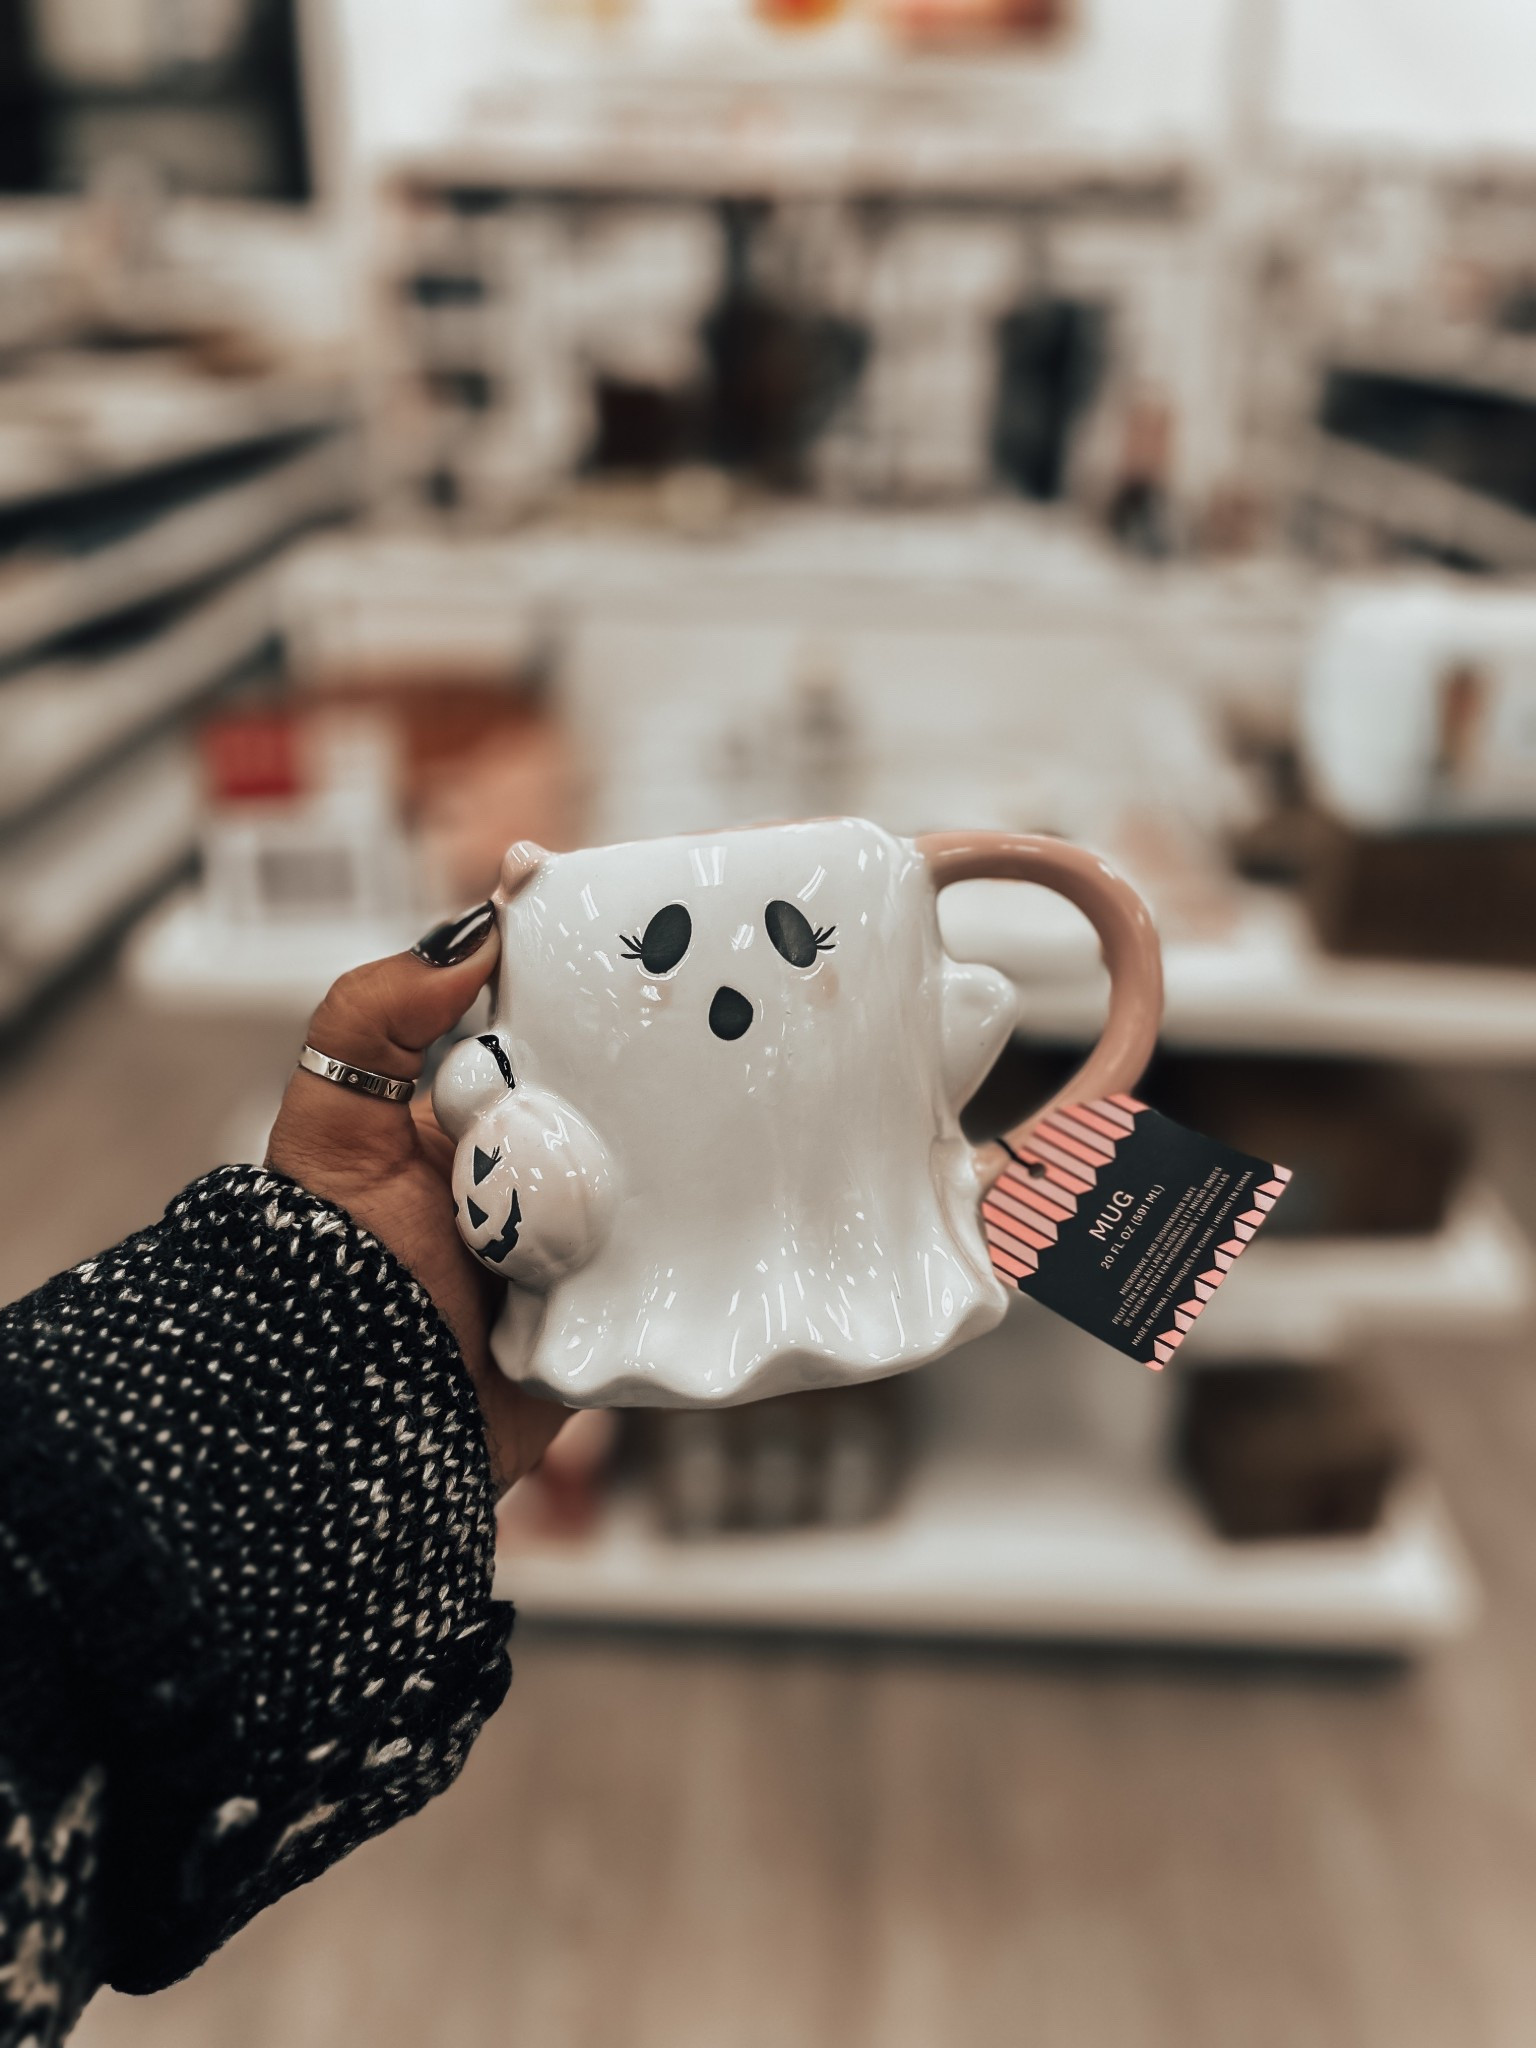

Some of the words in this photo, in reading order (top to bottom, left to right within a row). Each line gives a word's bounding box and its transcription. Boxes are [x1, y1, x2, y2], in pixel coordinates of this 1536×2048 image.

[1088, 1190, 1135, 1242] MUG
[1100, 1255, 1115, 1270] 20
[1110, 1242, 1125, 1255] FL
[1120, 1224, 1136, 1240] OZ
[1130, 1203, 1151, 1226] (591
[1144, 1184, 1166, 1204] ML)
[1213, 1201, 1233, 1225] HECHO
[1227, 1190, 1240, 1203] EN
[1234, 1171, 1254, 1192] CHINA
[1111, 1306, 1128, 1325] PEUT
[1134, 1277, 1148, 1291] MIS
[1143, 1267, 1154, 1279] AU
[1182, 1209, 1193, 1220] ET
[1118, 1257, 1149, 1296] MICROWAVE
[1145, 1242, 1159, 1258] AND
[1154, 1201, 1187, 1243] DISHWASHER
[1181, 1186, 1197, 1202] SAFE
[1122, 1317, 1133, 1328] SE
[1128, 1296, 1148, 1318] PUEDE
[1143, 1273, 1163, 1296] METER
[1157, 1262, 1169, 1276] EN
[1164, 1221, 1198, 1265] MICROONDAS
[1192, 1214, 1202, 1224] Y
[1190, 1246, 1202, 1259] EN
[1197, 1228, 1215, 1248] CHINE
[1131, 1326, 1148, 1347] MADE
[1144, 1316, 1154, 1328] IN
[1150, 1297, 1169, 1319] CHINA
